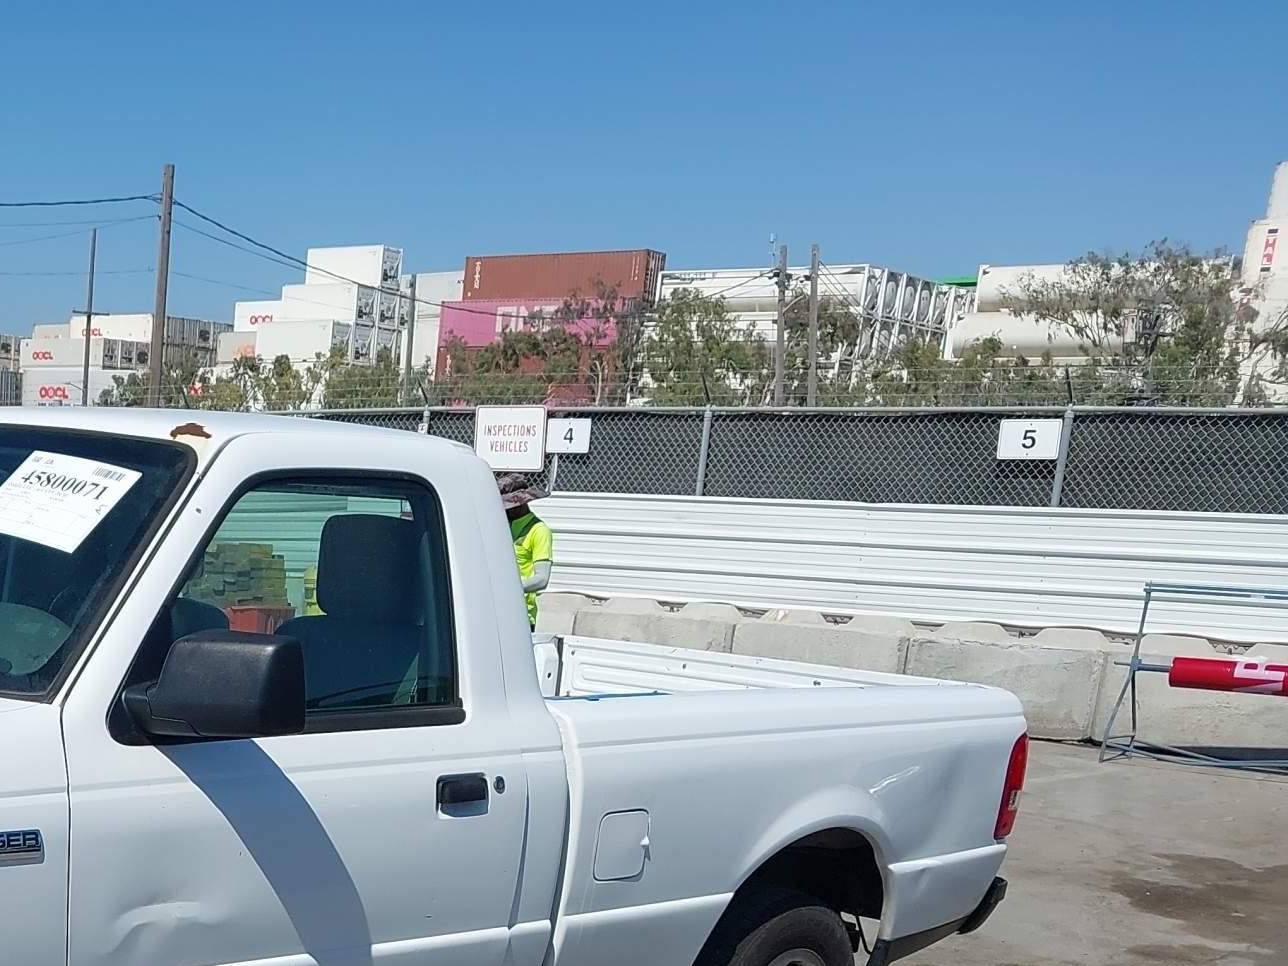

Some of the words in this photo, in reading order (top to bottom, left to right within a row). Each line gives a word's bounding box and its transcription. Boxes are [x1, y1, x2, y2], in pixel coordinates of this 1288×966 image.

[32, 351, 53, 360] OOCL
[39, 387, 68, 399] OOCL
[484, 424, 537, 437] INSPECTIONS
[563, 427, 574, 444] 4
[1021, 429, 1037, 449] 5
[490, 440, 529, 453] VEHICLES
[21, 470, 109, 500] 45800071
